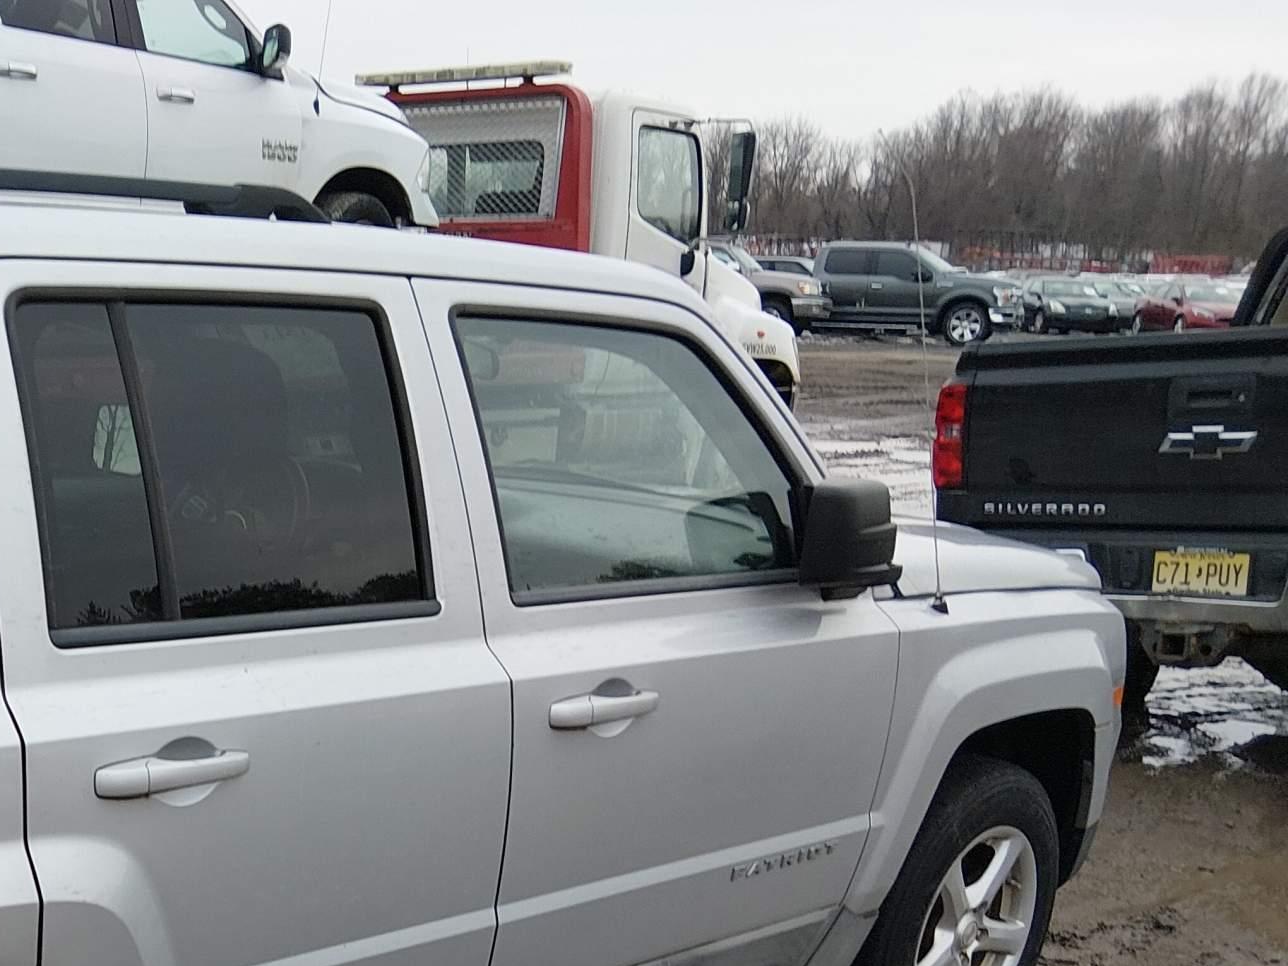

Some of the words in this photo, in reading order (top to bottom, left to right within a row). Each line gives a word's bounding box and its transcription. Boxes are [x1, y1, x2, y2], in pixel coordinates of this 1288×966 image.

[984, 502, 1106, 516] SILVERADO
[1155, 561, 1190, 586] C71
[1205, 562, 1243, 587] PUY
